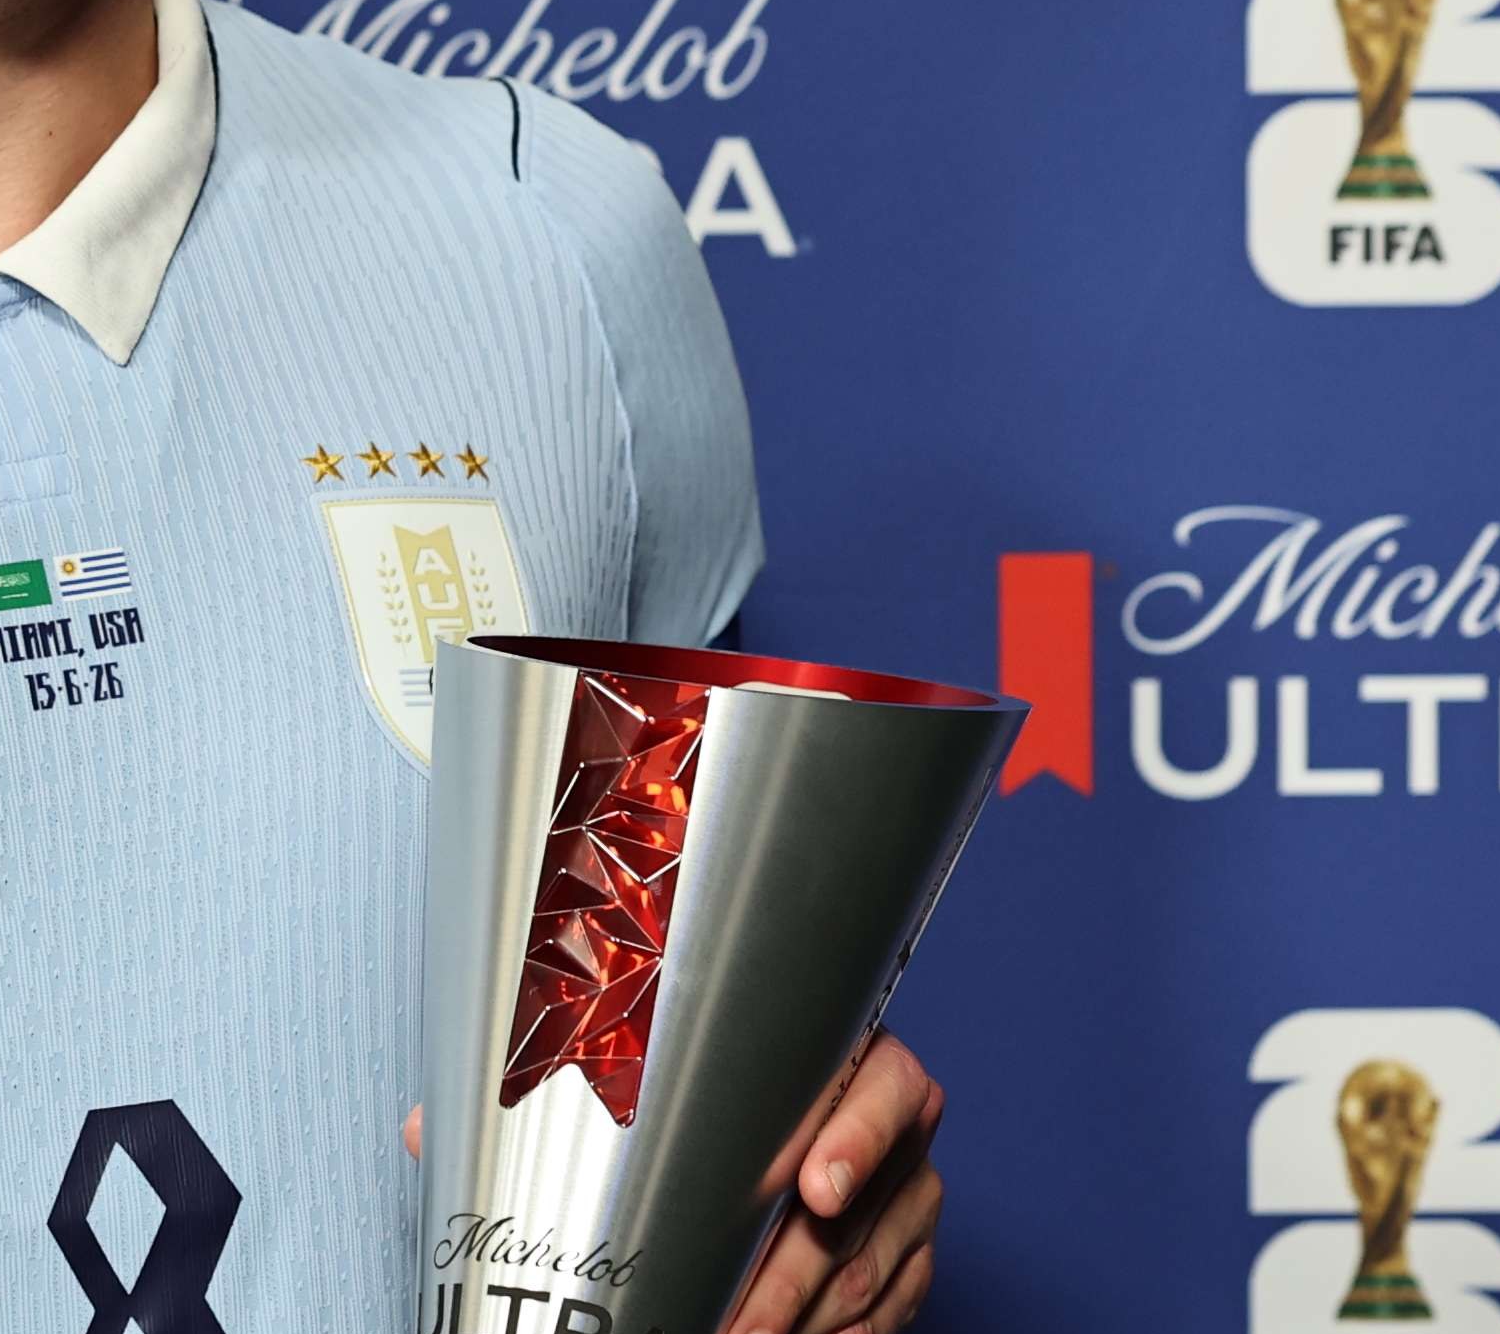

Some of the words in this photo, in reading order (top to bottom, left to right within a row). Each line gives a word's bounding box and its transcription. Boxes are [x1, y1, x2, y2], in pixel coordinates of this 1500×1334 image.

[1329, 225, 1444, 264] FIFA
[88, 607, 145, 650] USA
[433, 1212, 644, 1288] Michelob
